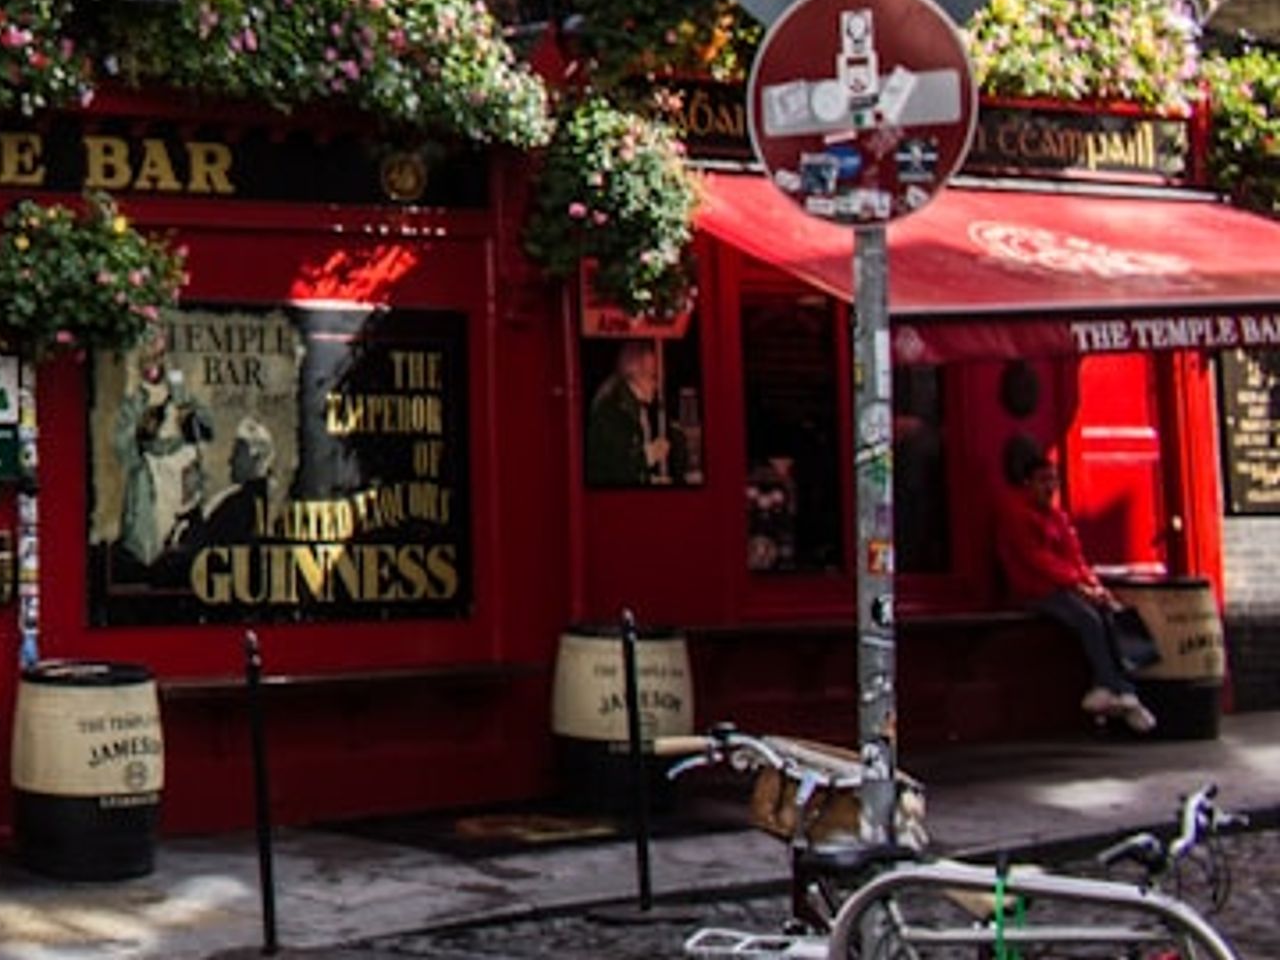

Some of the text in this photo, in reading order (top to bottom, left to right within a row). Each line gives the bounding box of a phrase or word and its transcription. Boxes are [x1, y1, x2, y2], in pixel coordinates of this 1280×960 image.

[82, 134, 238, 195] BAR
[1070, 315, 1280, 351] THE TEMPLE BA
[202, 354, 264, 389] BAR
[389, 350, 444, 391] THE
[325, 392, 443, 436] EMPEROR
[412, 440, 444, 479] OF
[189, 543, 459, 605] GUINNESS
